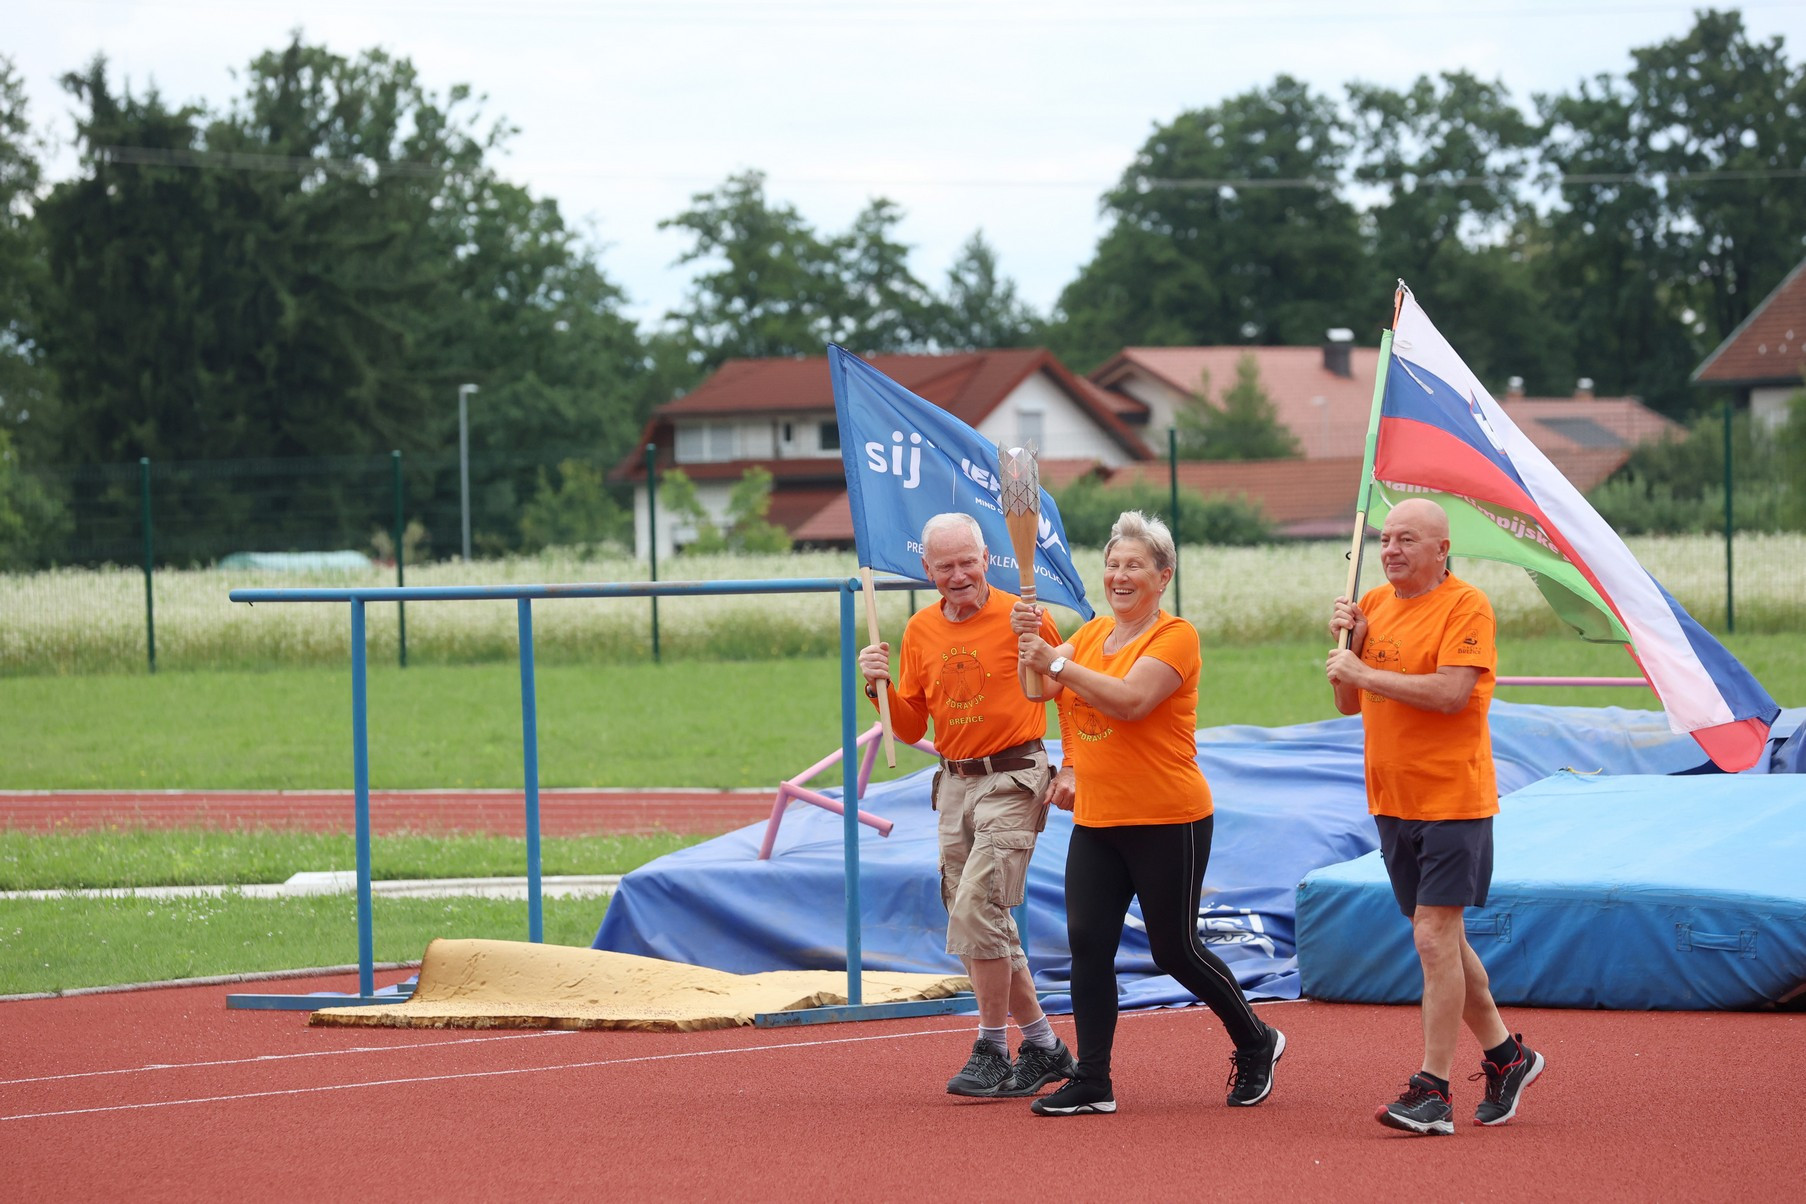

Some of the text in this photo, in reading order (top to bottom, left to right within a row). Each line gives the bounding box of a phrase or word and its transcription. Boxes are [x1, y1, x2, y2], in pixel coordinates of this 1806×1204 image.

[865, 431, 922, 489] sij
[975, 497, 996, 511] MIND
[906, 541, 925, 555] PRE
[945, 694, 985, 710] ZDRAVJA
